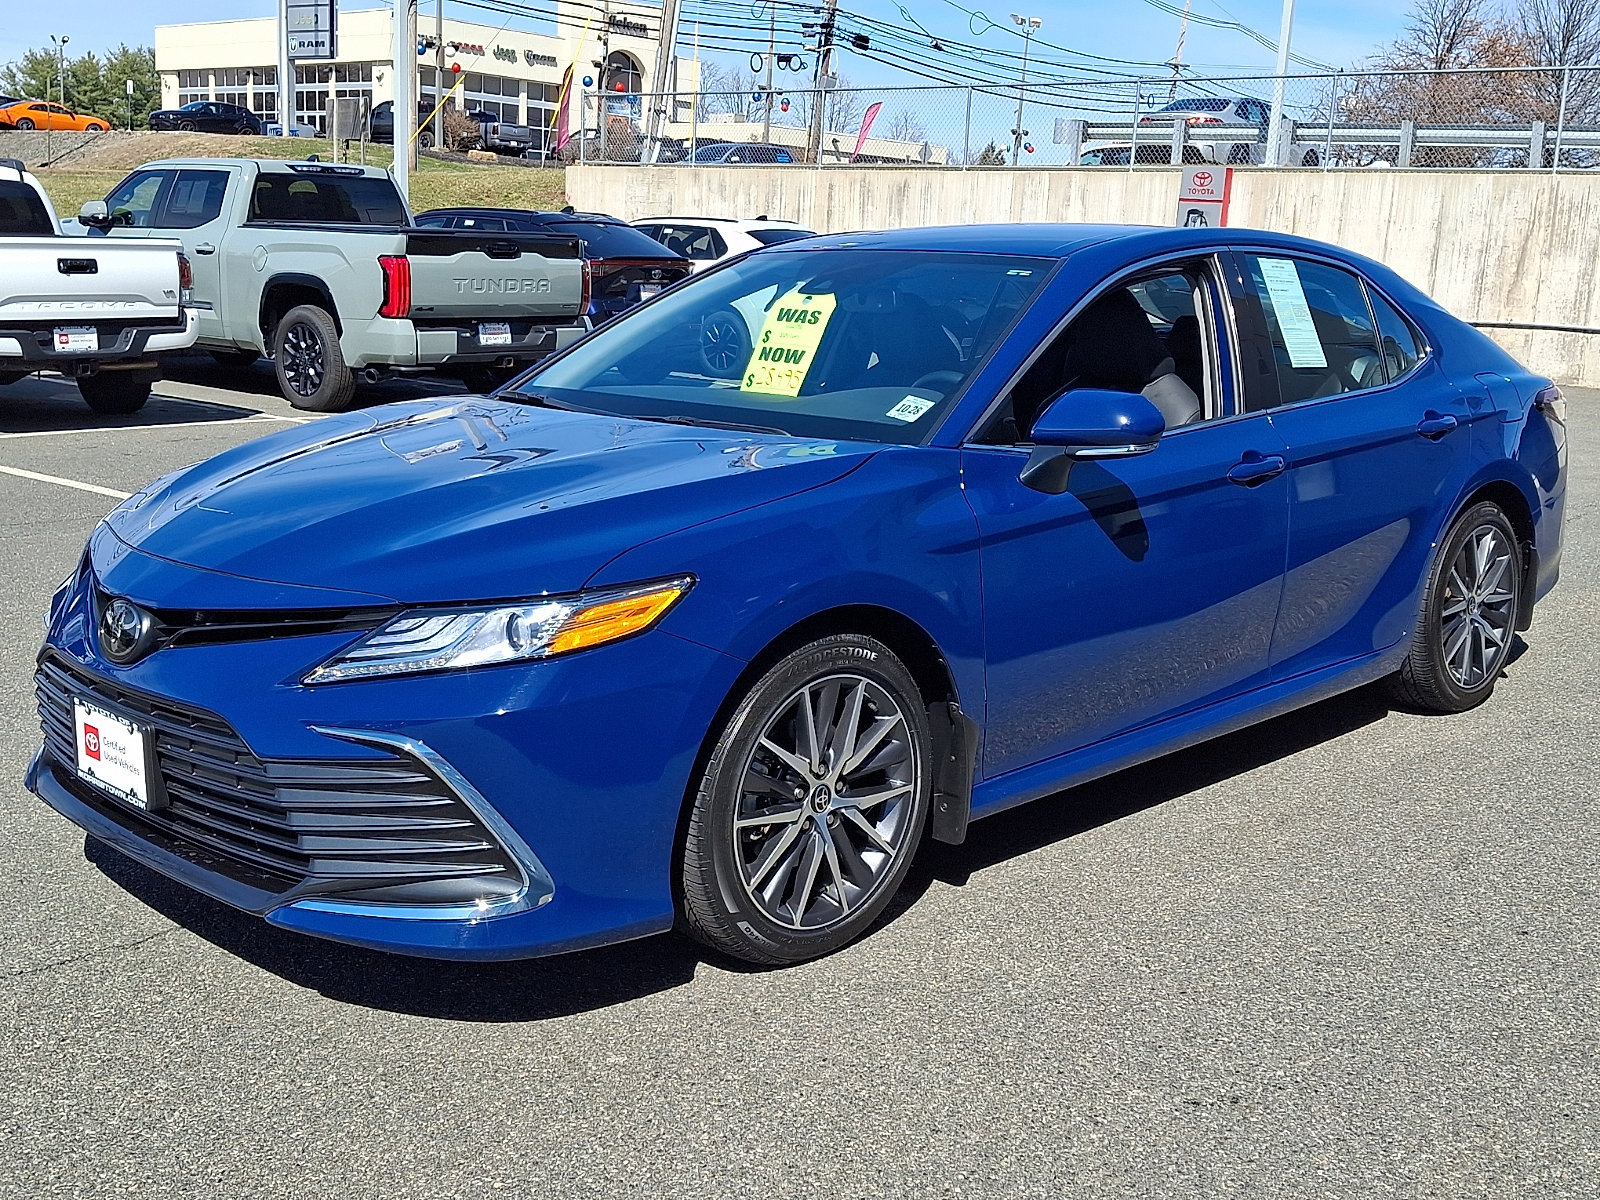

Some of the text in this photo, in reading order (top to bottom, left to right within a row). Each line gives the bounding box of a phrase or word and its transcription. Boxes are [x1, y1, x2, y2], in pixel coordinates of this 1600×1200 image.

[298, 40, 326, 48] RAM
[493, 44, 517, 61] Jeep
[1188, 187, 1215, 195] TOYOTA
[452, 278, 552, 294] TUNDRA
[777, 307, 822, 325] WAS
[762, 329, 772, 344] $
[758, 346, 806, 365] NOW
[103, 750, 140, 776] Used Vehicles
